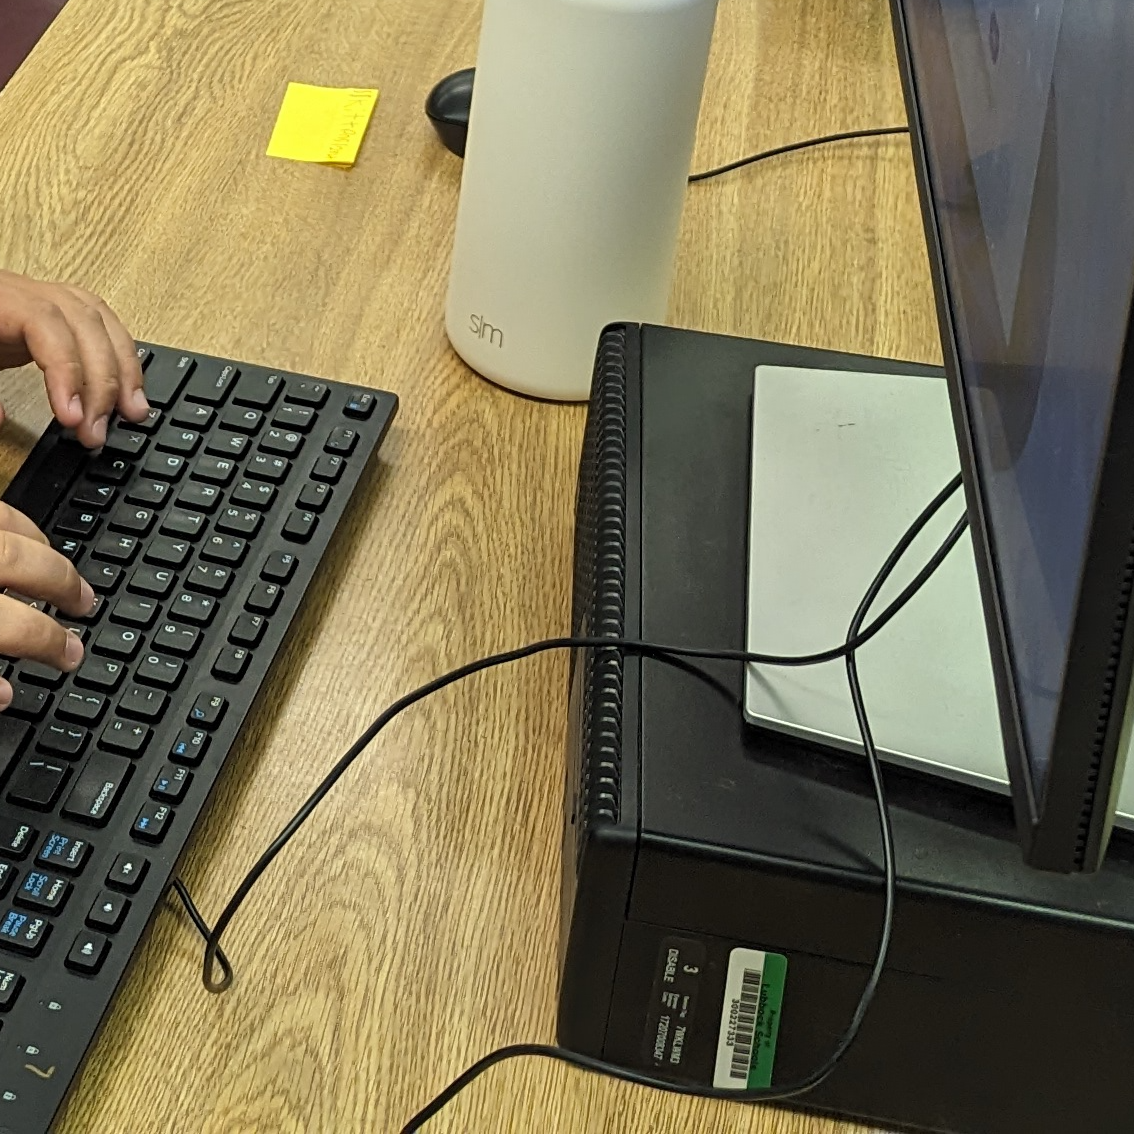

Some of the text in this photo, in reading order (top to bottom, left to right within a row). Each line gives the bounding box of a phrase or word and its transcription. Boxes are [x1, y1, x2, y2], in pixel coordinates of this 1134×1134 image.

[231, 438, 243, 447] W
[331, 457, 339, 465] F2
[98, 488, 112, 496] V
[63, 541, 76, 550] N
[119, 538, 132, 547] H
[282, 555, 291, 563] F5
[156, 572, 168, 580] U
[267, 585, 277, 593] F6
[252, 617, 260, 626] F7
[123, 632, 134, 640] O
[107, 664, 120, 674] P
[211, 697, 220, 706] F9
[192, 732, 203, 744] F10
[174, 769, 185, 780] F11
[90, 781, 114, 815] Backspace
[155, 807, 167, 819] F12
[12, 826, 29, 847] Delete
[66, 840, 83, 862] Insert
[24, 872, 40, 891] Lock
[46, 879, 64, 901] Home
[26, 918, 43, 940] PgUp
[664, 948, 679, 983] DISABLE
[684, 965, 698, 974] 3
[0, 973, 14, 991] Num
[726, 998, 739, 1047] 300227333
[749, 984, 770, 1070] Lubbock Schools
